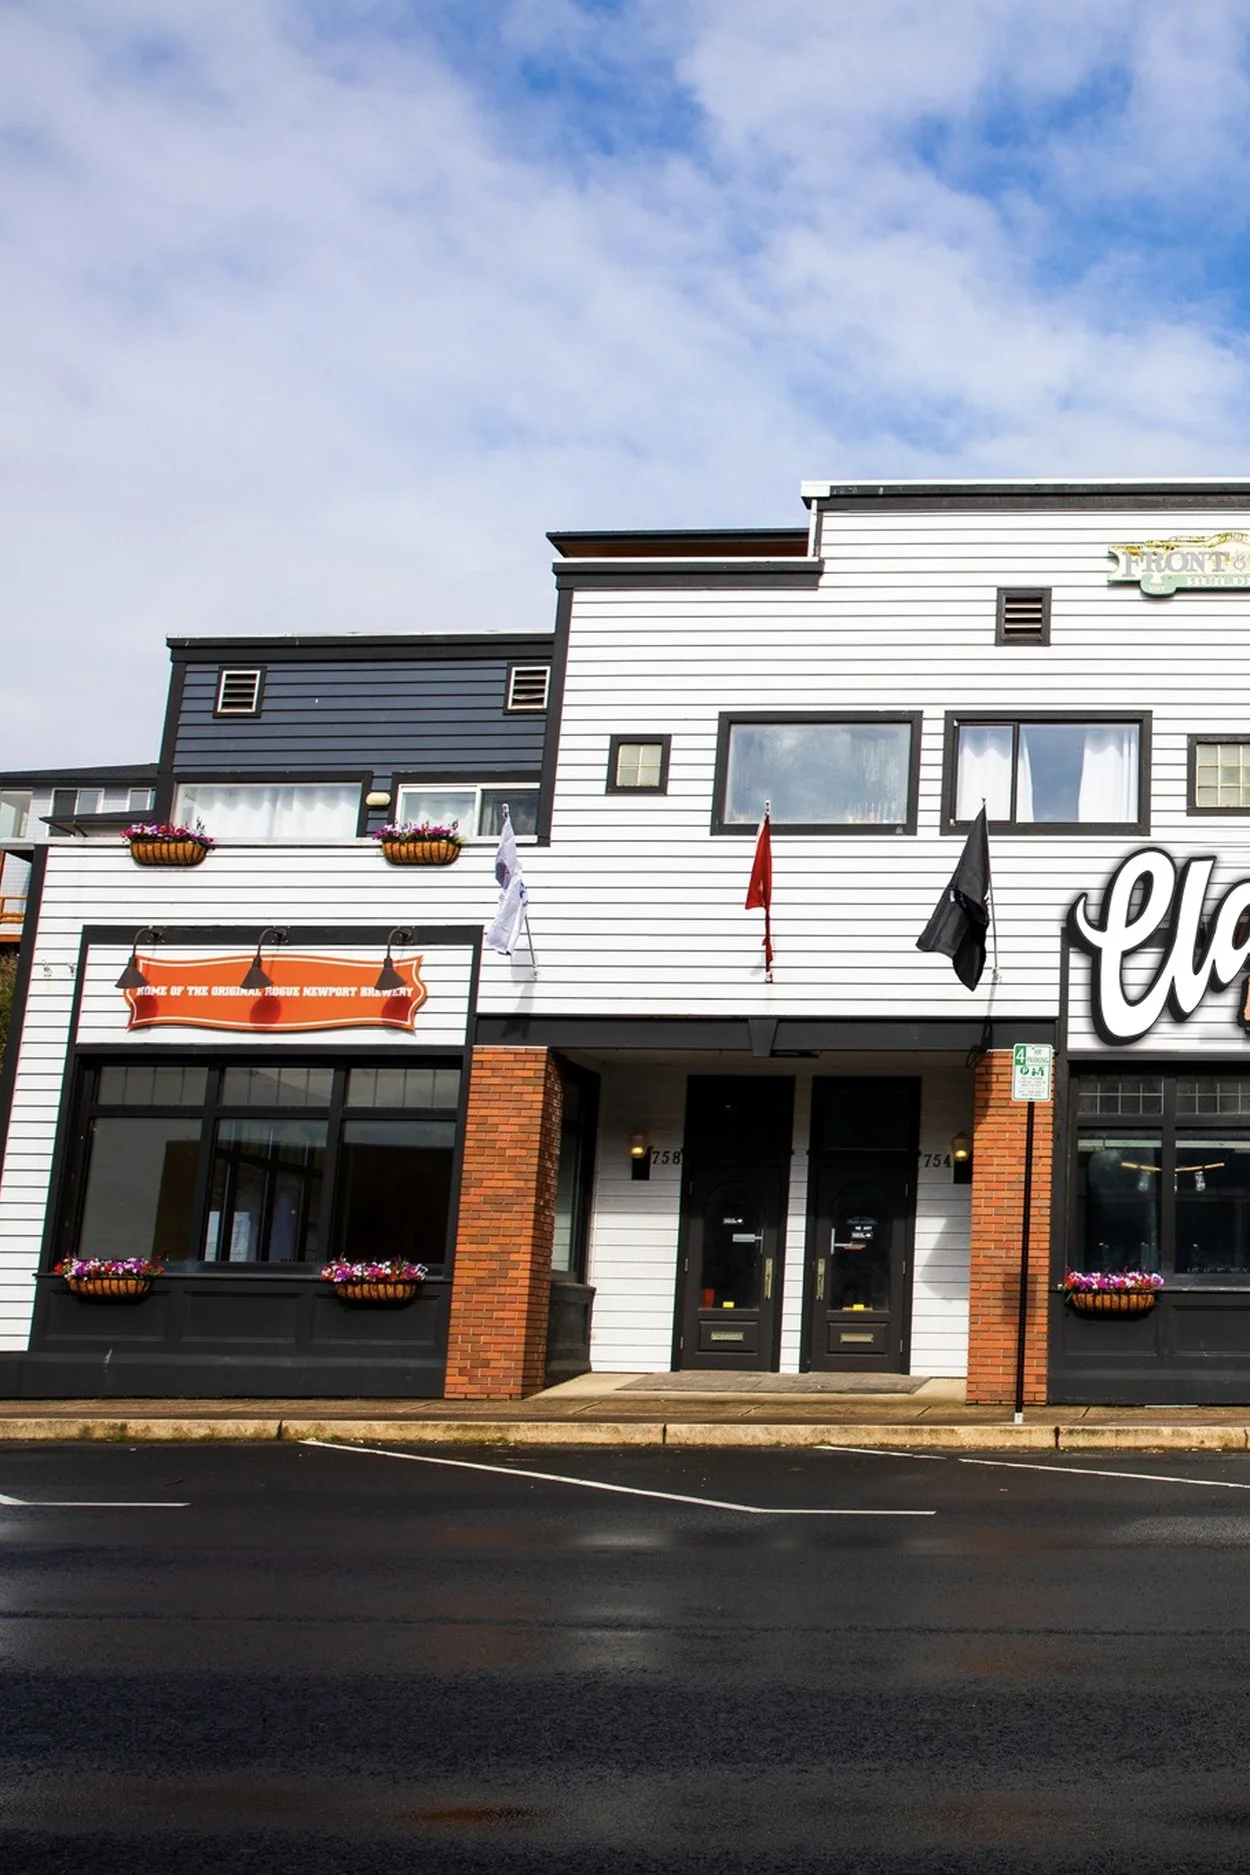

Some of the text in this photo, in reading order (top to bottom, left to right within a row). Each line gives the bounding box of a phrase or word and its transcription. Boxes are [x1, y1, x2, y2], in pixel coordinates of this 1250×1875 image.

[1121, 551, 1229, 577] FRONT
[136, 986, 414, 997] HOME OF THE ORIGINAL ROGUE NEWPORT BREWERY
[1016, 1049, 1025, 1063] 4
[652, 1150, 681, 1165] 758
[923, 1153, 952, 1168] 754
